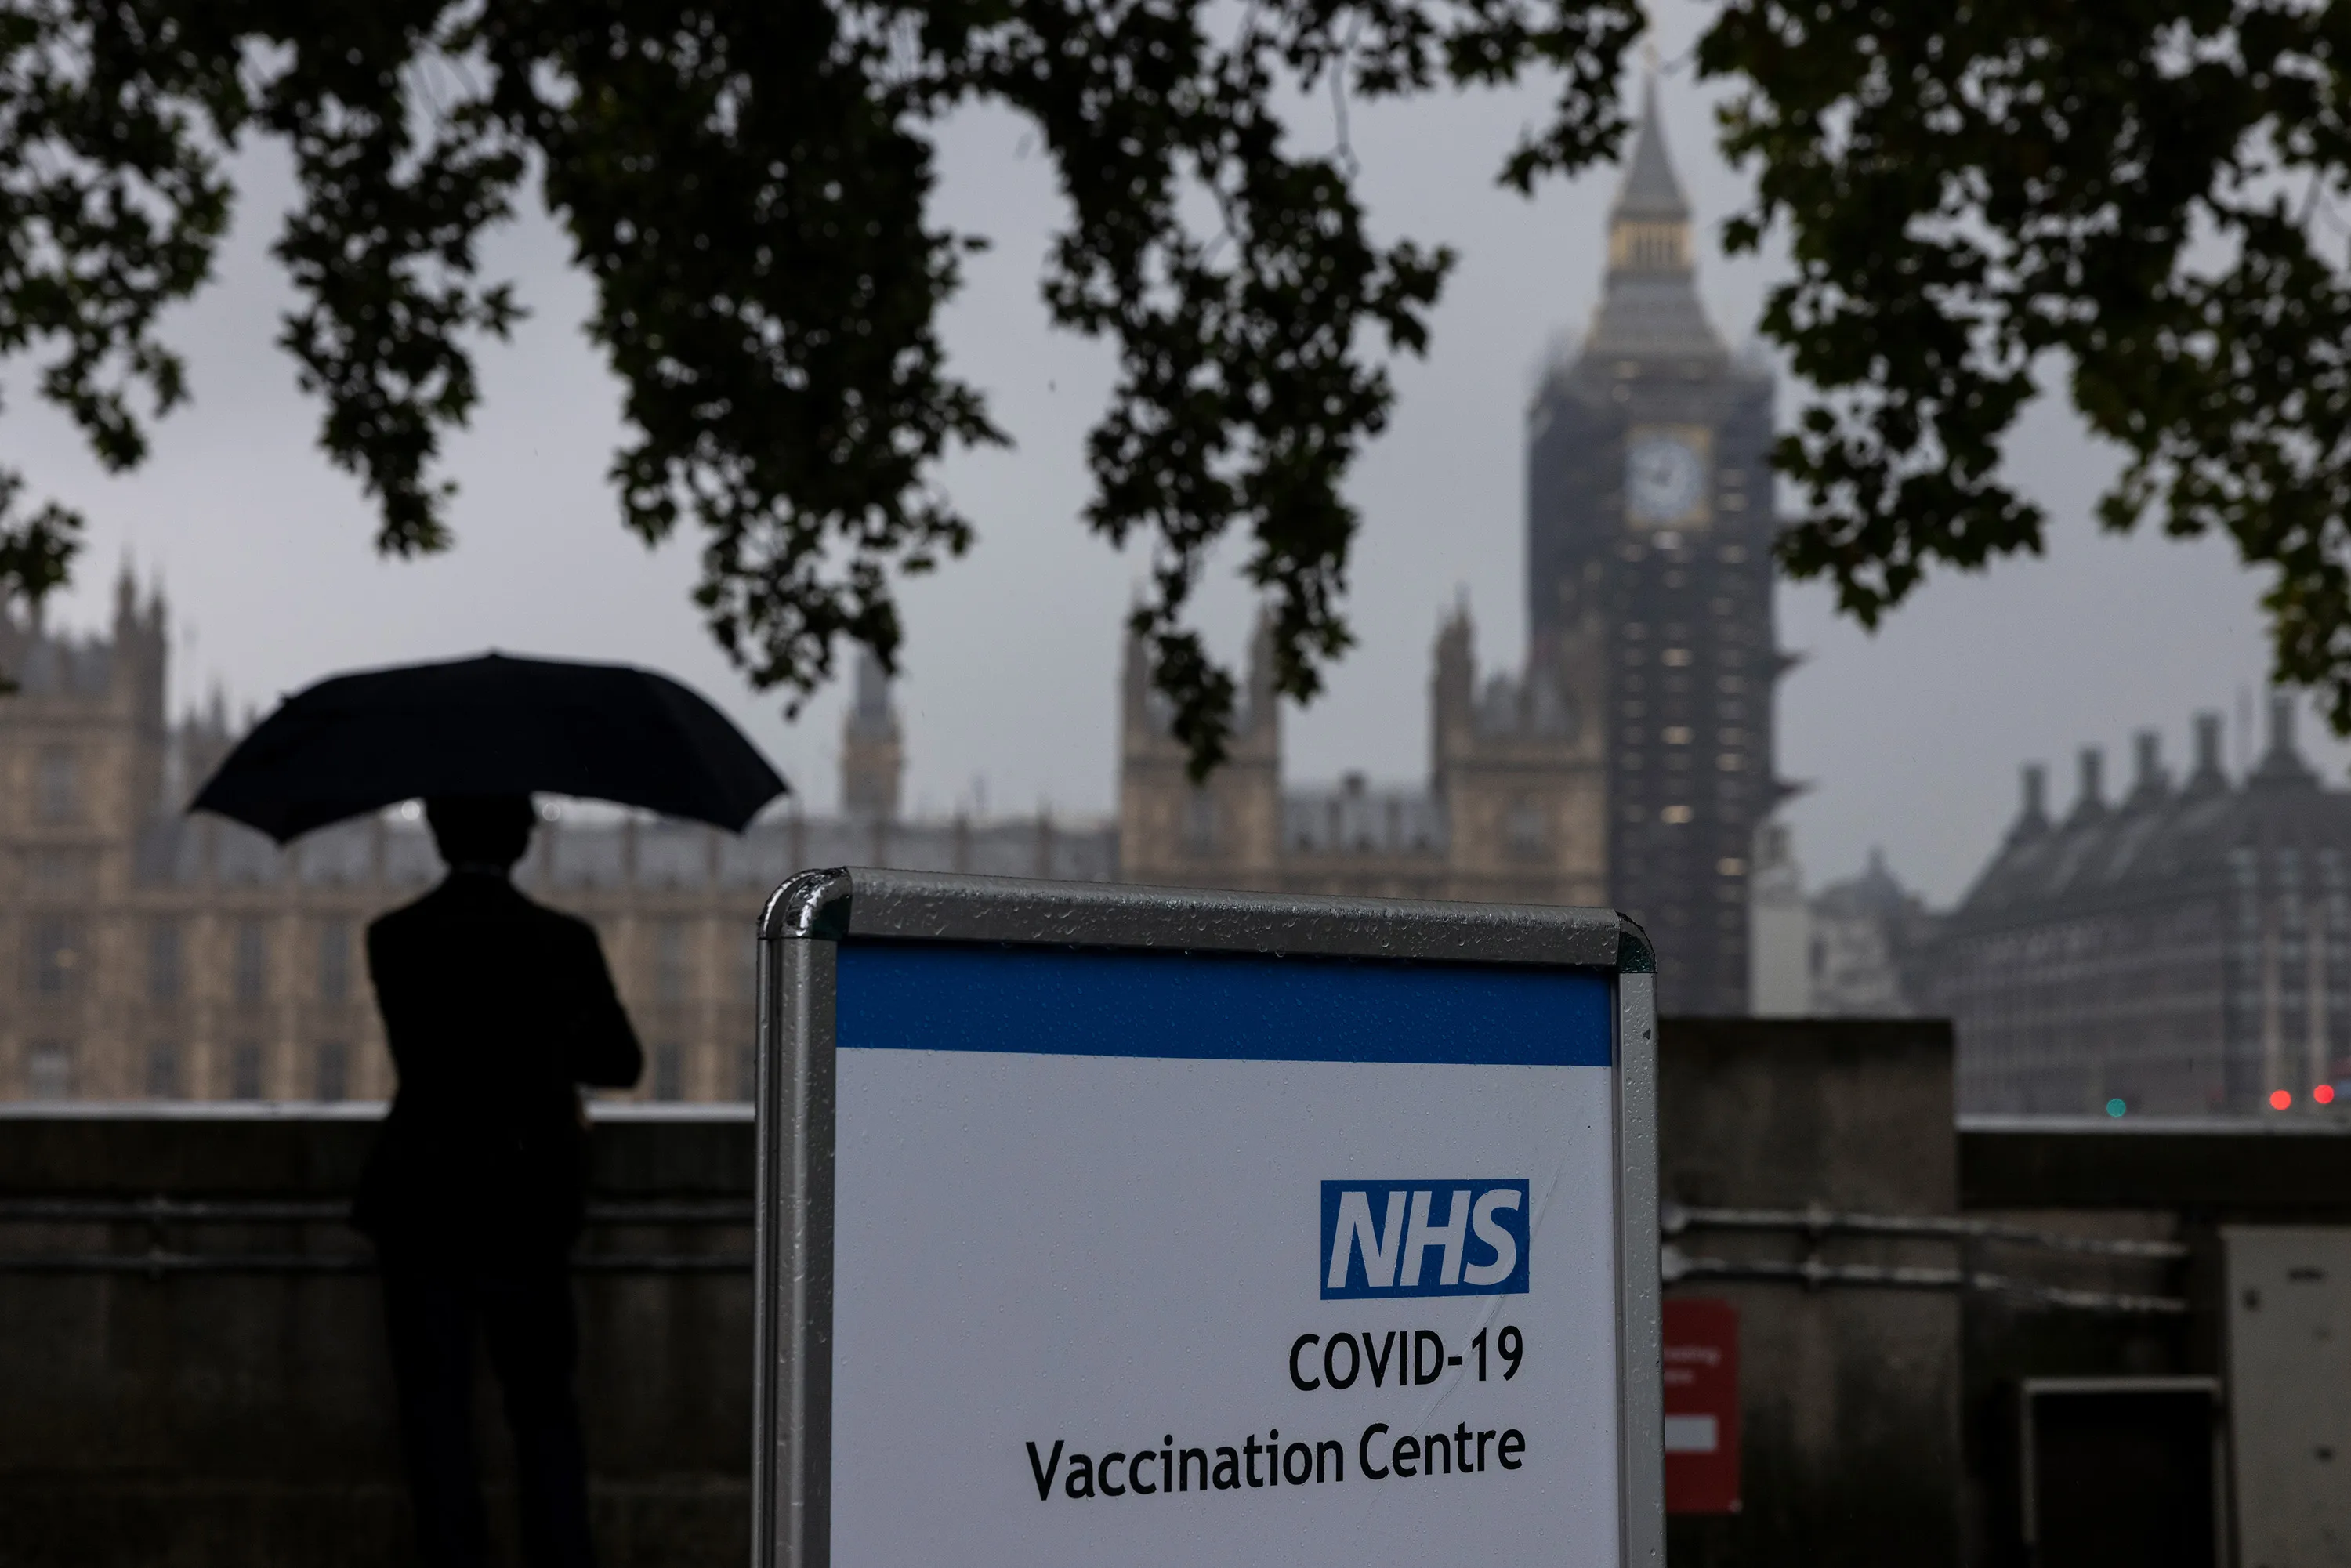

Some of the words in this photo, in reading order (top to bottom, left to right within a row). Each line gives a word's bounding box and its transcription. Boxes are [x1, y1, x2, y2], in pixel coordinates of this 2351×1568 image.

[1327, 1188, 1522, 1289] NHS
[1289, 1325, 1523, 1392] COVID-19
[1025, 1429, 1344, 1501] Vaccination
[1359, 1421, 1526, 1480] Centre
